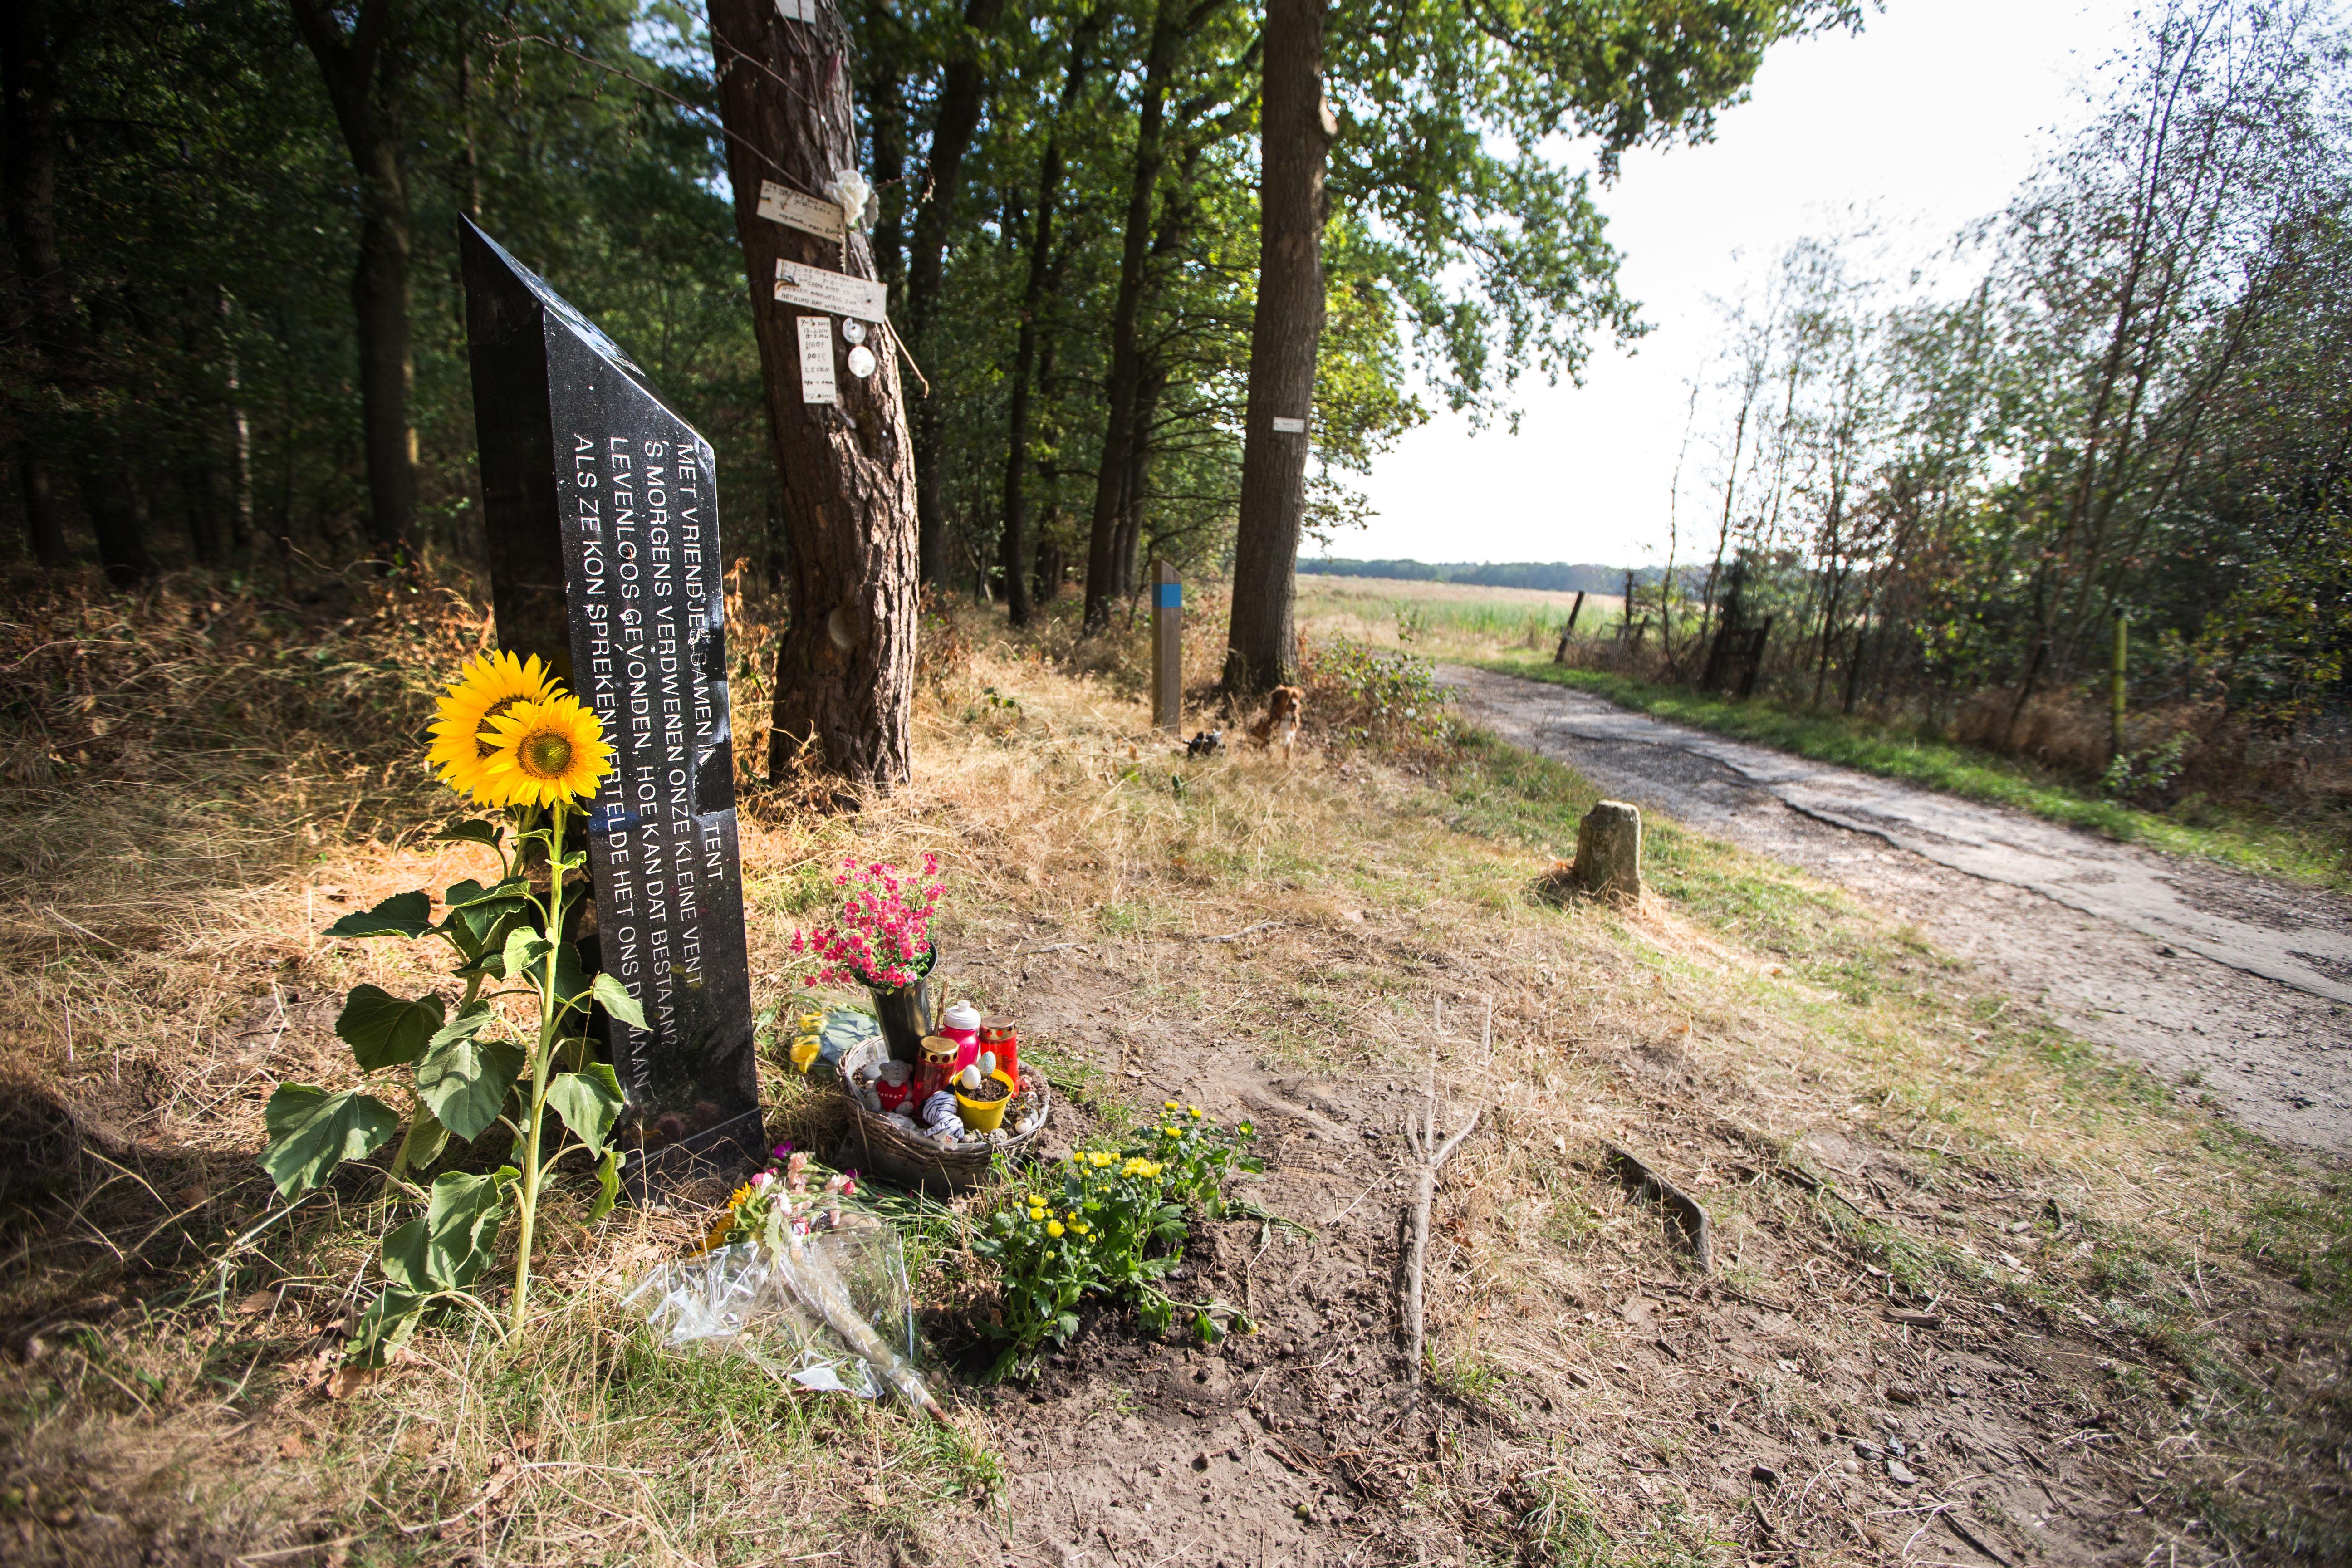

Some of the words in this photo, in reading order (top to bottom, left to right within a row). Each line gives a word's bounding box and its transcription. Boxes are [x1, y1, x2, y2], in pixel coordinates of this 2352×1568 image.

[794, 295, 809, 304] KIND
[574, 433, 598, 488] ALS
[677, 444, 697, 499] MET
[579, 497, 602, 532] ZE
[610, 436, 640, 599] LEVENLOOS
[646, 465, 672, 597] MORGENS
[583, 541, 606, 595] KON
[681, 507, 706, 645] VRIENDJES
[589, 604, 617, 726] SPREKEN
[624, 608, 652, 757] GEVONDEN,
[657, 605, 684, 762] VERDWENEN
[691, 652, 713, 736] SAMEN
[600, 733, 630, 865] VERTELDE
[637, 765, 658, 817] HOE
[669, 769, 691, 835] ONZE
[642, 822, 662, 876] KAN
[704, 821, 724, 880] TENT
[612, 871, 634, 916] HET
[647, 880, 666, 922] DAT
[675, 841, 697, 922] KLEINE
[618, 926, 639, 977] ONS
[682, 926, 703, 985] VENT
[651, 929, 677, 1045] BESTAAN?
